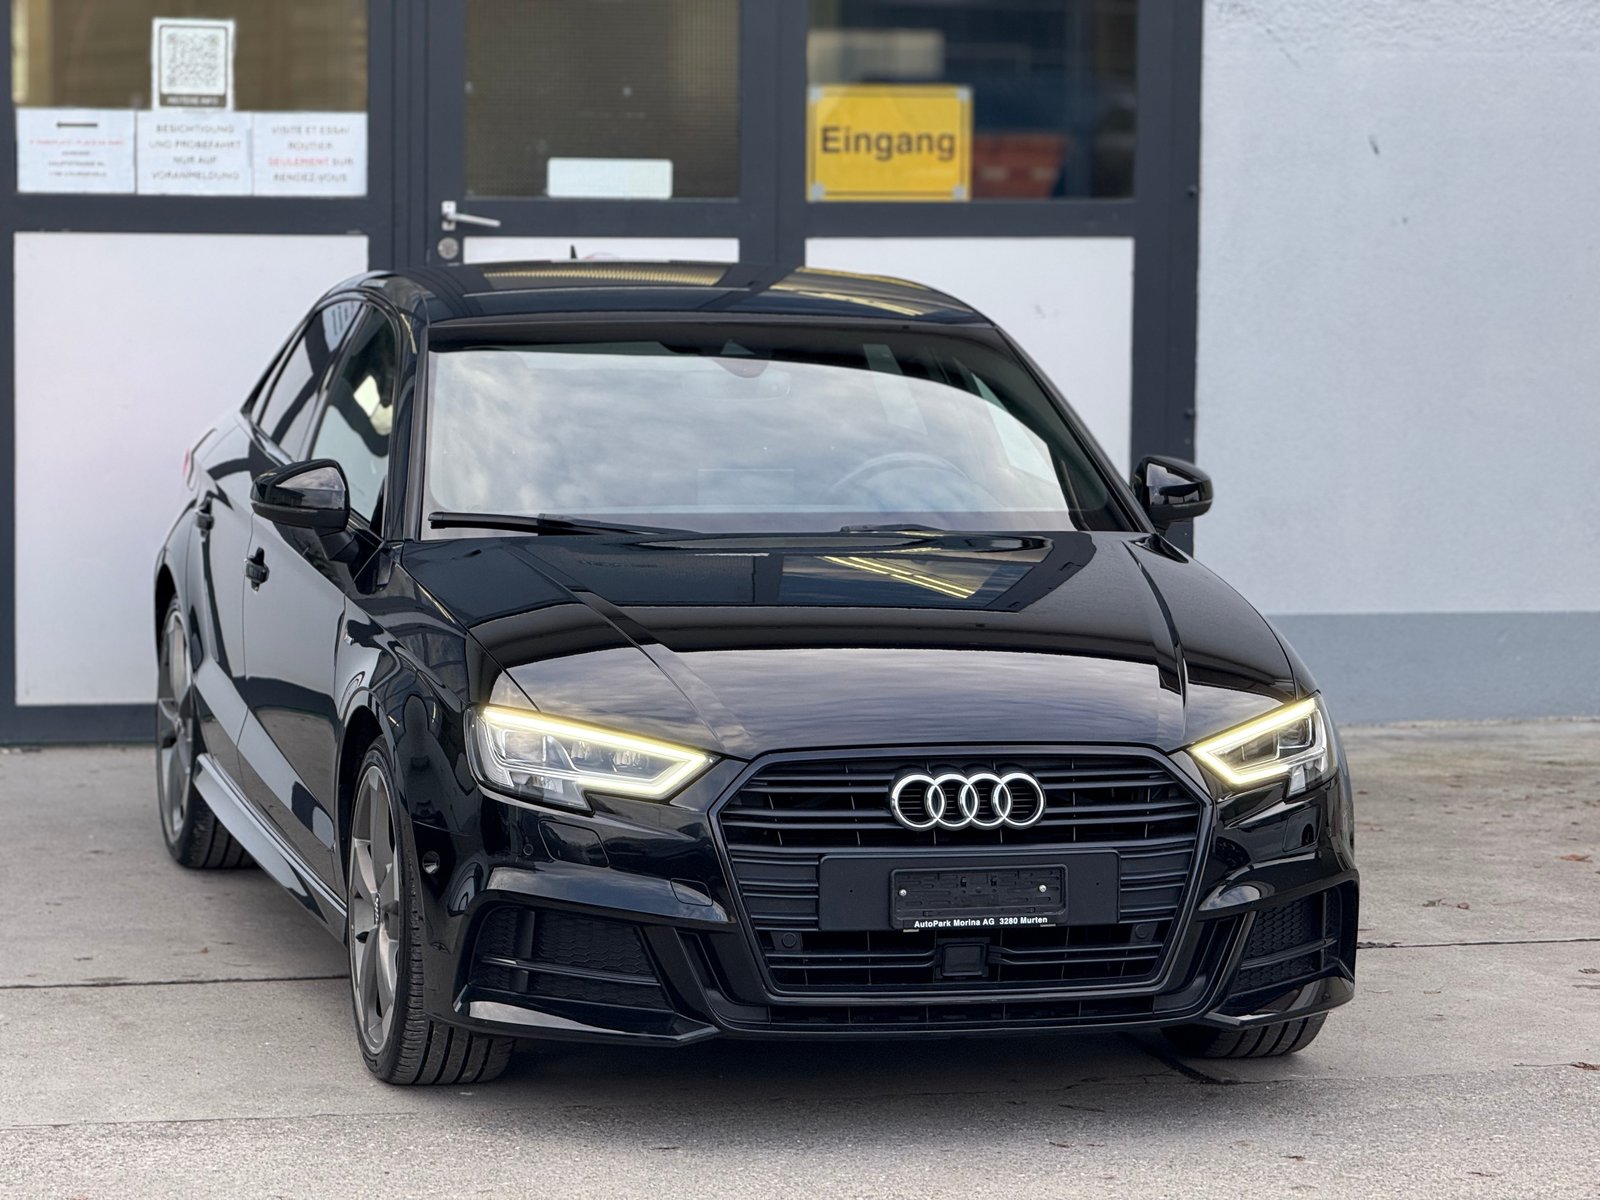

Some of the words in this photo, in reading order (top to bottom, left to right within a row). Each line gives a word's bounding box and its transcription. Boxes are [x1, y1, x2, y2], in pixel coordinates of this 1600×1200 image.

[821, 125, 956, 162] Eingang
[914, 920, 952, 928] AutoPark
[953, 919, 981, 927] Morina
[982, 918, 995, 926] AG
[999, 917, 1018, 925] 3280
[1020, 916, 1048, 924] Murten
